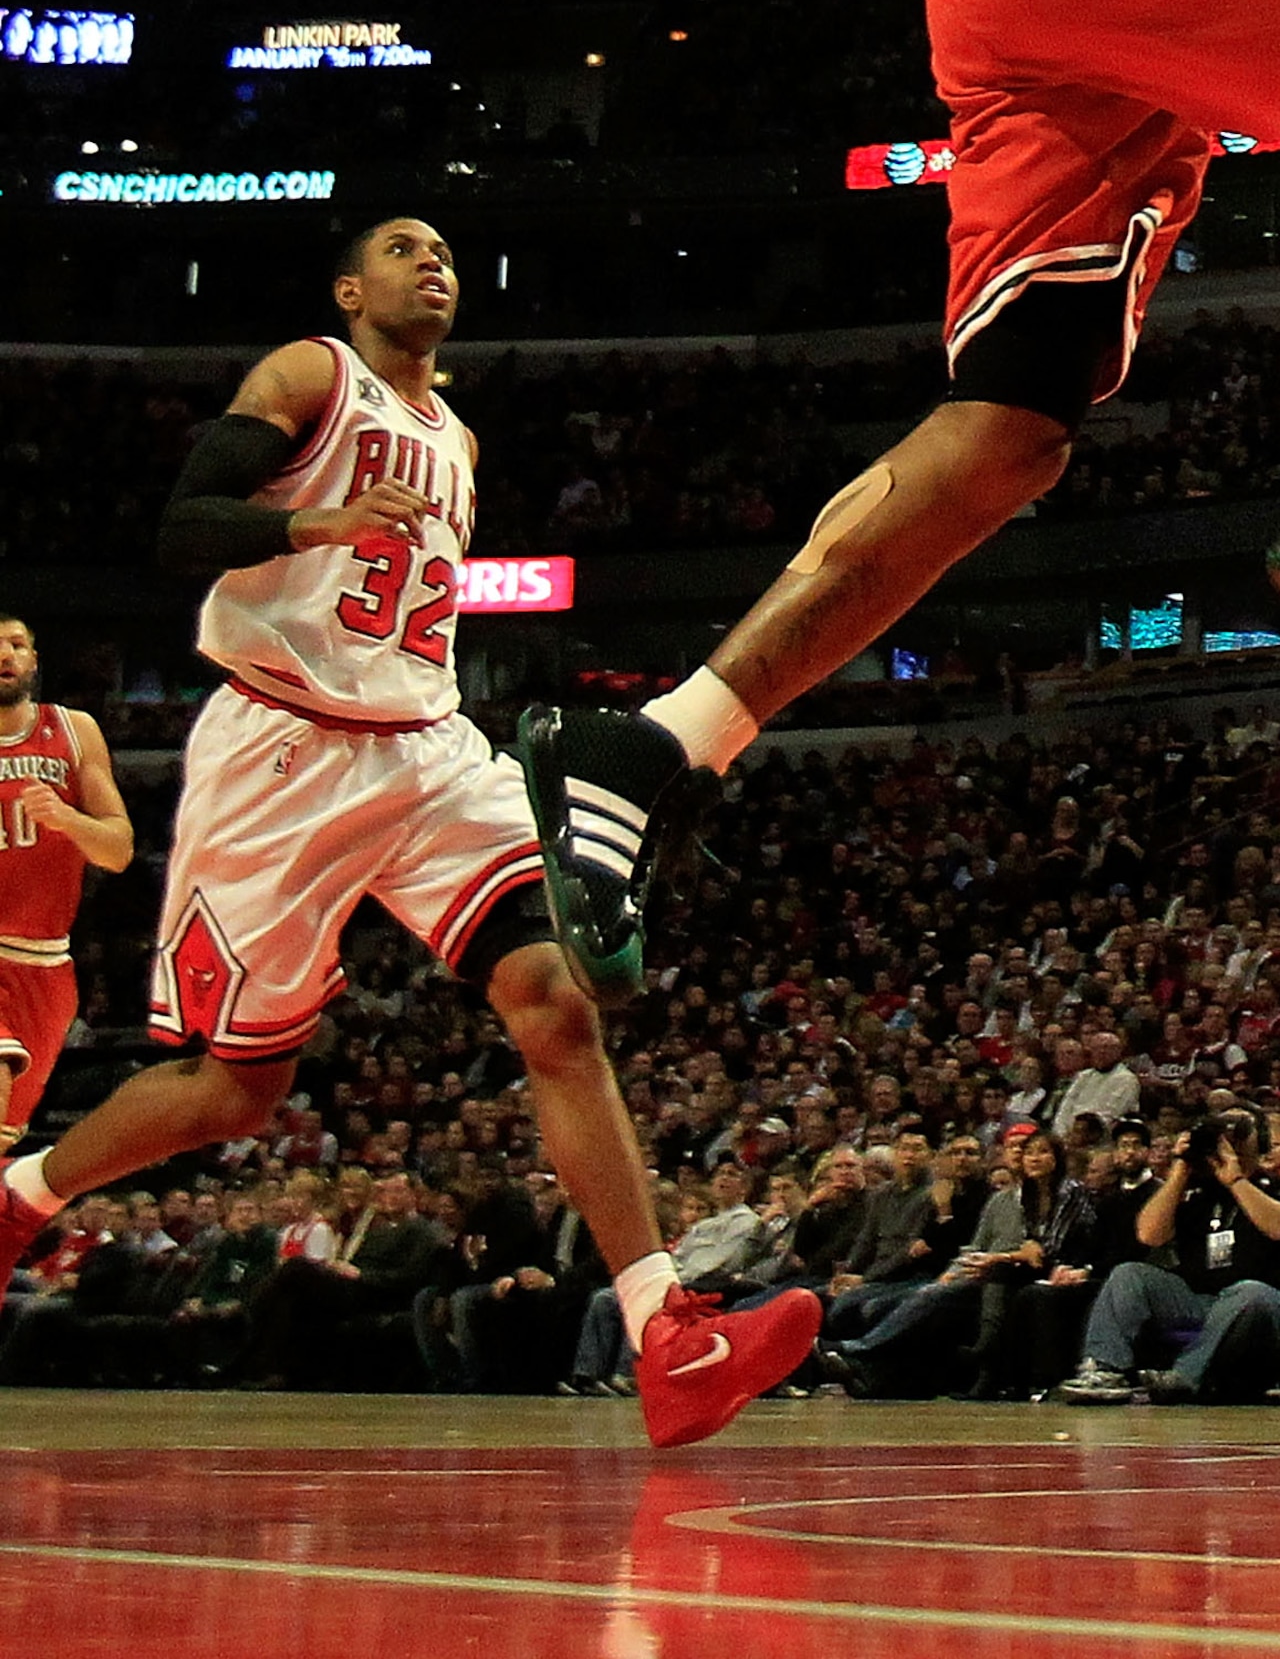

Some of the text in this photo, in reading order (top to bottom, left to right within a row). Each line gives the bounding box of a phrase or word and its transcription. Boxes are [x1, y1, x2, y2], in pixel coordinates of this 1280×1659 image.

[263, 22, 401, 49] LINKIN PARK
[229, 46, 323, 69] JANUARY
[55, 171, 334, 202] CSNCHICAGO.COM
[344, 430, 478, 555] BULL
[336, 538, 454, 668] 32
